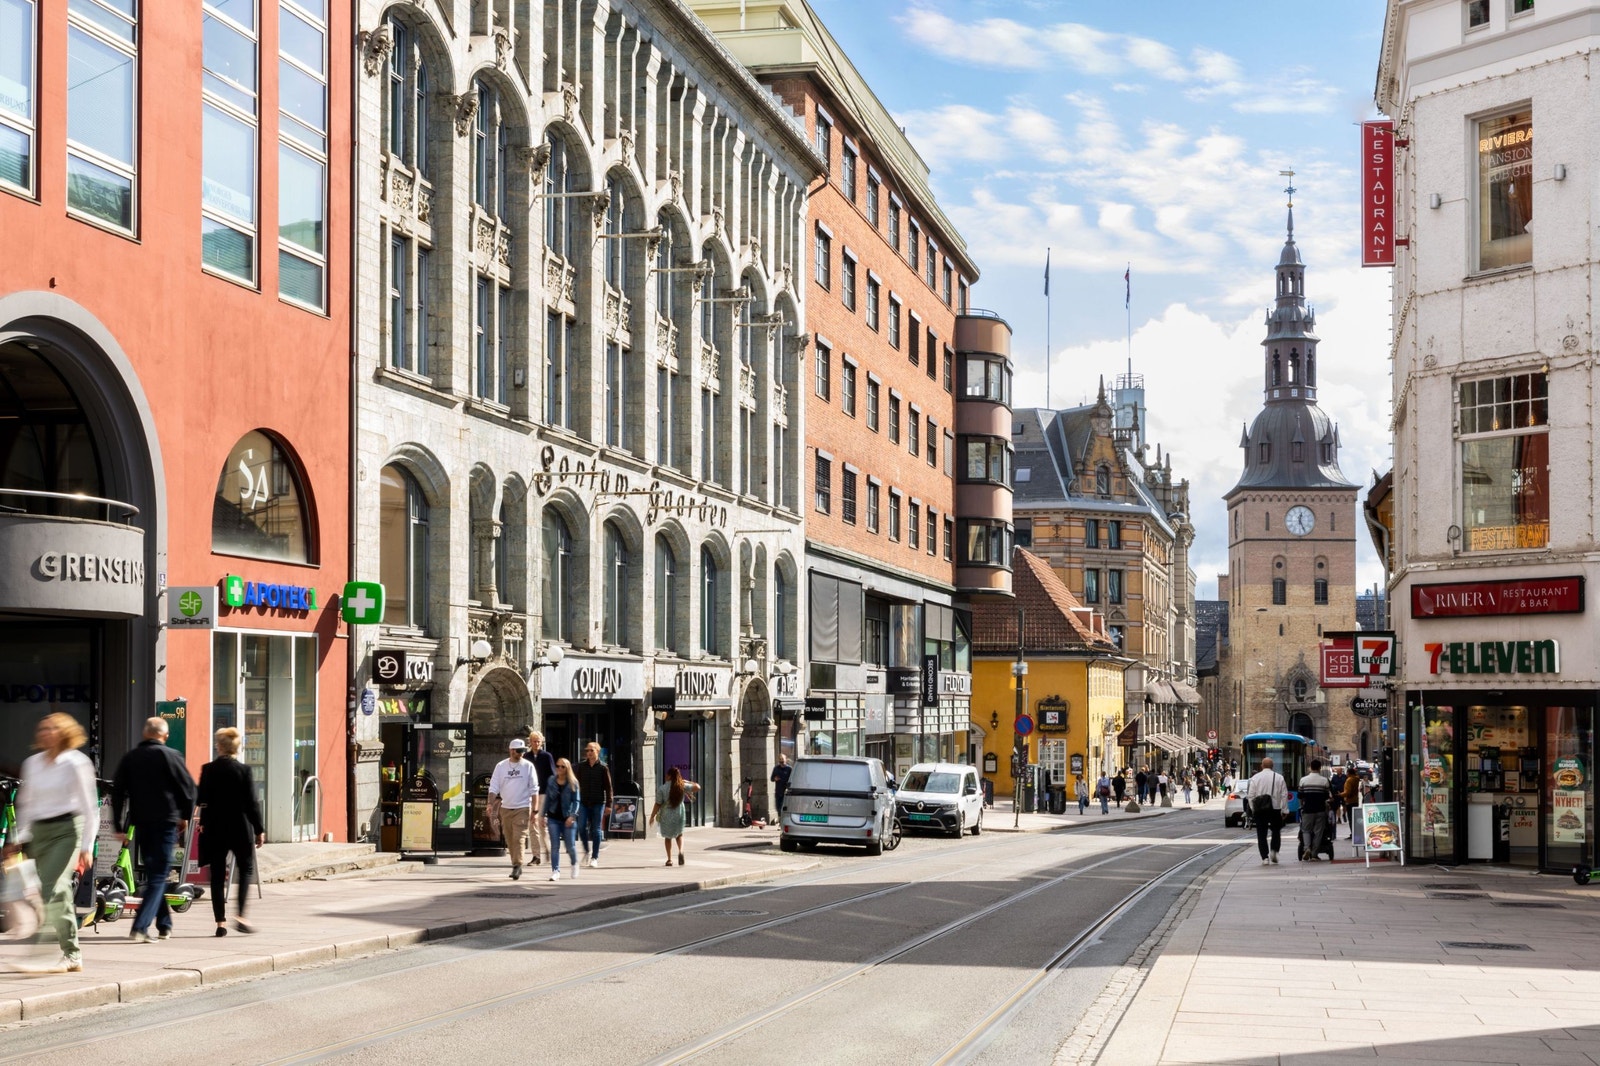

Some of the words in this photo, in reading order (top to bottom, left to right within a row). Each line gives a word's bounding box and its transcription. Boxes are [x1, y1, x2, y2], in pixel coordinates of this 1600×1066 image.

[1479, 128, 1533, 152] RIVIERA
[1373, 126, 1385, 259] RESTAURANT
[245, 582, 310, 610] APOTEK
[1436, 592, 1496, 608] RIVIERA
[1503, 587, 1569, 598] RESTAURANT
[1520, 600, 1527, 608] &
[1530, 599, 1549, 608] BAR
[414, 660, 433, 680] CAT
[580, 667, 622, 693] OUTLAND
[681, 671, 718, 695] LINDEX
[176, 707, 185, 718] 9B
[1555, 796, 1583, 808] NYHET!
